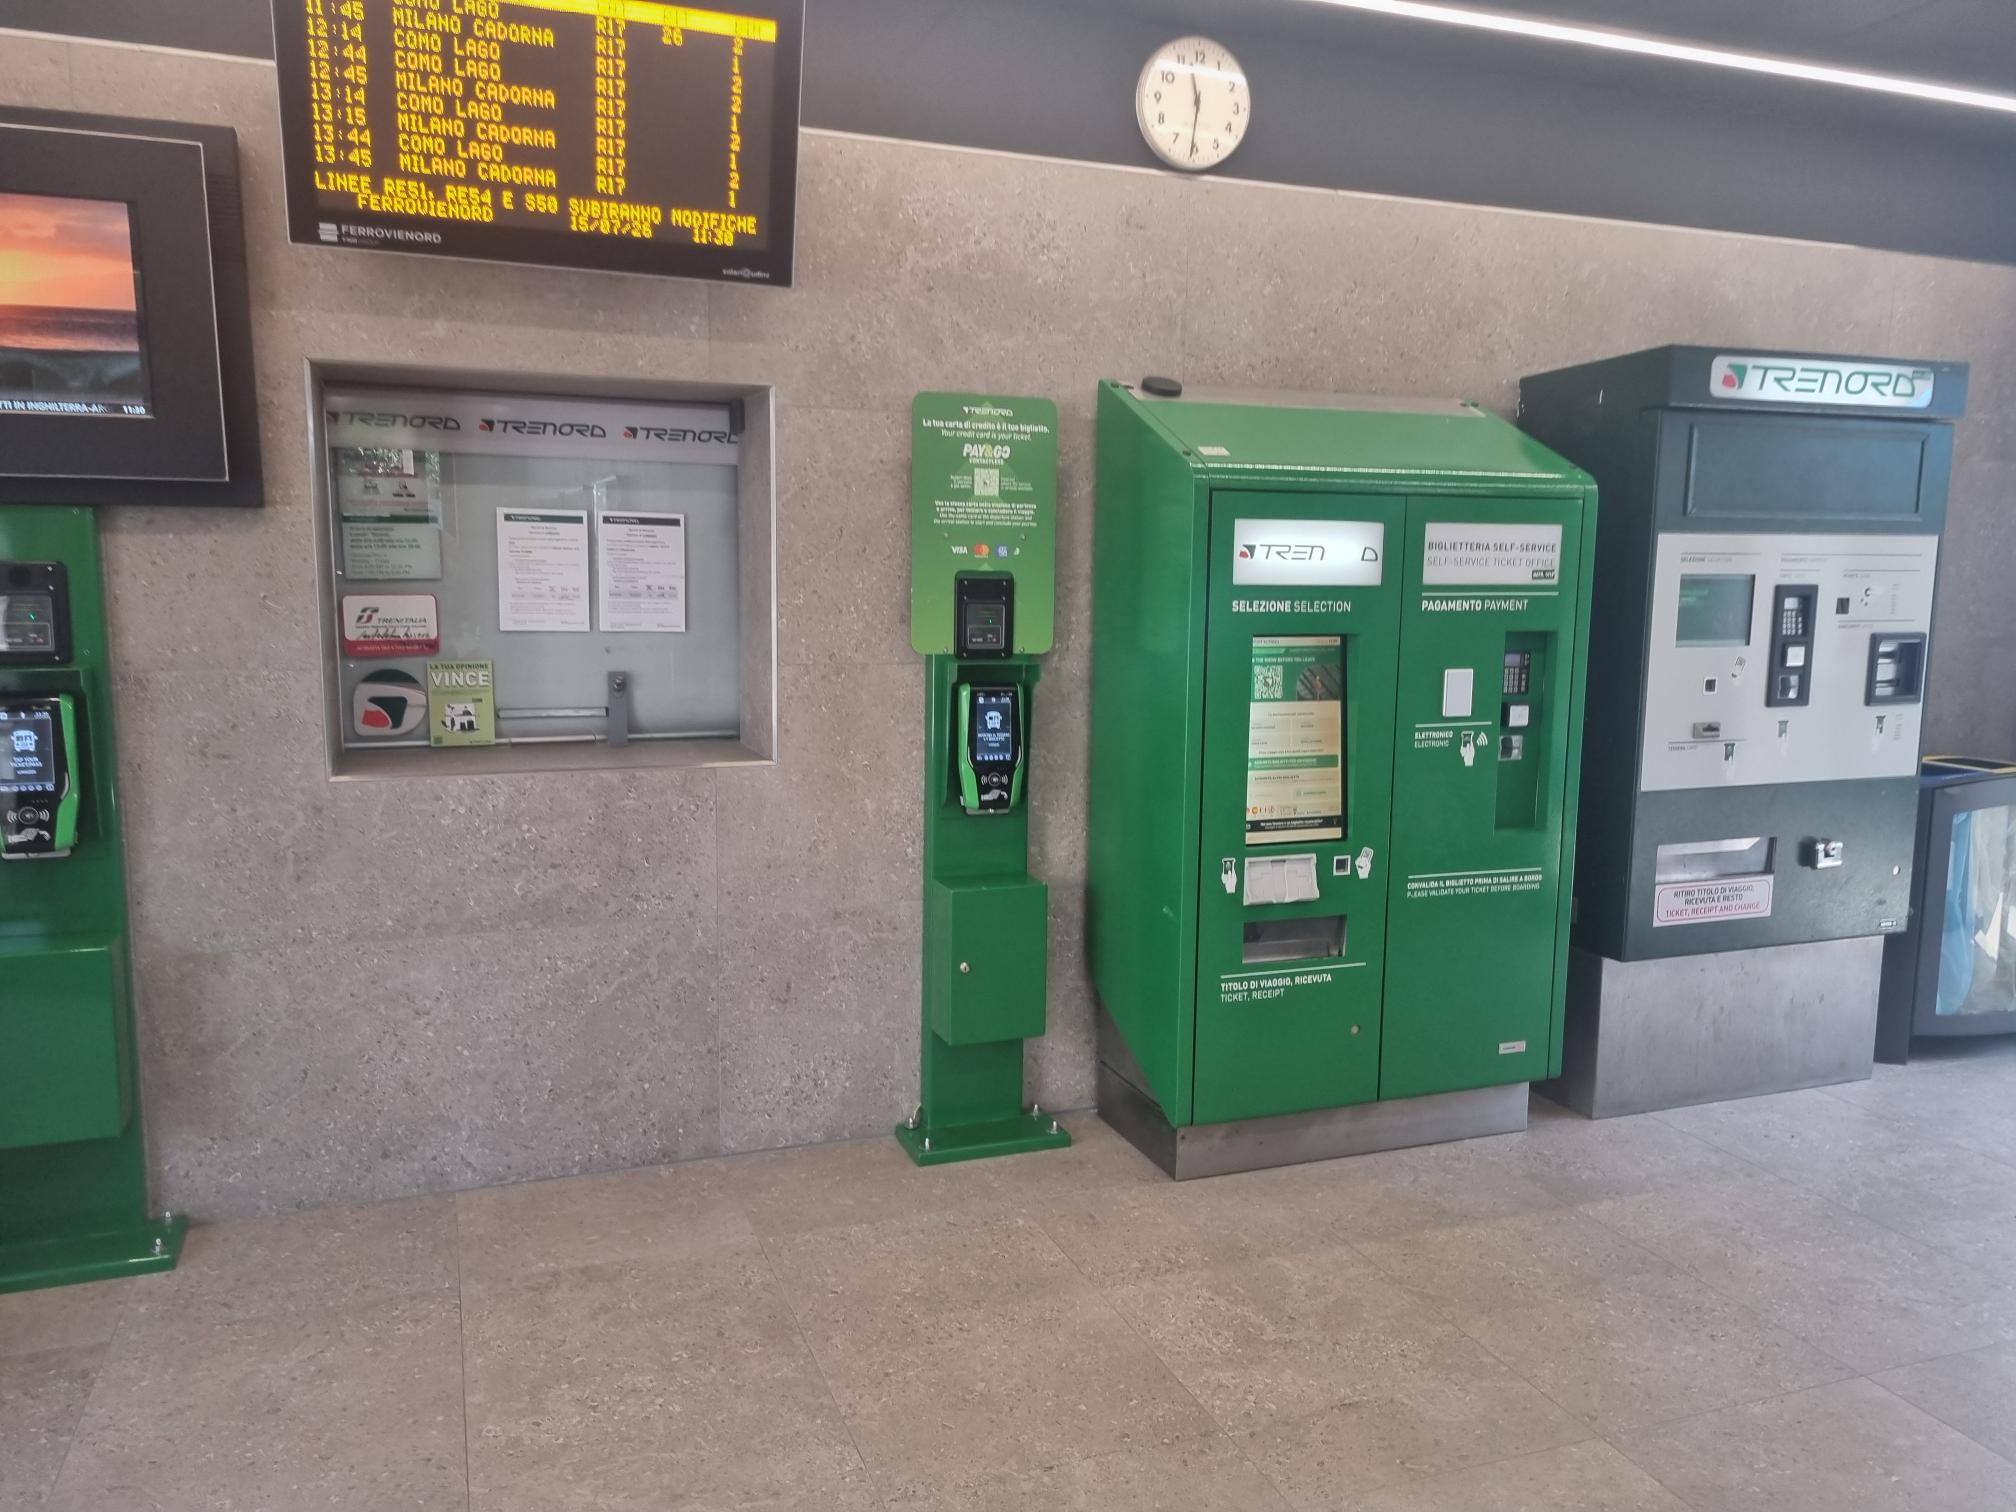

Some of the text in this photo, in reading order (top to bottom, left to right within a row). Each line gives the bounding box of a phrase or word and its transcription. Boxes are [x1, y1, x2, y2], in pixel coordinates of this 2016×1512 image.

[595, 16, 626, 38] R17
[306, 0, 740, 75] 11:45 MILANO CADORNA R17 1
[307, 16, 362, 42] 12:14
[393, 27, 442, 53] COMO
[453, 36, 500, 61] LAGO
[595, 55, 626, 78] R17
[1177, 55, 1186, 65] 11
[1195, 50, 1206, 65] 12
[308, 38, 366, 64] 12:44
[394, 49, 442, 74] COMO
[454, 57, 500, 82] LAGO
[595, 75, 626, 98] R17
[1217, 60, 1221, 71] 1
[1161, 70, 1175, 84] 10
[1229, 81, 1235, 93] 2
[310, 59, 738, 133] 12:45 MILANO CADORNA R17 1
[1154, 90, 1162, 103] 9
[312, 80, 365, 105] 13:14
[396, 91, 444, 115] COMO
[455, 98, 502, 122] LAGO
[595, 115, 626, 138] R17
[1232, 102, 1239, 115] 3
[1157, 111, 1165, 125] 8
[1225, 121, 1232, 135] 4
[312, 102, 737, 171] 13:15 MILANO CADORNA R17 1
[1172, 132, 1180, 144] 7
[313, 123, 370, 147] 13:44
[398, 133, 445, 156] COMO
[456, 139, 503, 162] LAGO
[595, 155, 626, 177] R17
[1212, 138, 1219, 150] 5
[315, 143, 735, 208] 13:45 MILANO CADORNA R17 1
[315, 170, 372, 194] LINEE
[502, 190, 514, 210] E
[568, 198, 662, 225] SUBIRANNO
[341, 224, 442, 244] FERROVIENORD
[1751, 365, 1915, 397] TRENORD
[969, 406, 1014, 416] TRENORD
[342, 412, 460, 431] TRENORD
[922, 418, 931, 427] La
[932, 419, 944, 428] tua
[945, 420, 962, 429] carta
[963, 421, 970, 429] di
[971, 421, 995, 430] credito
[1008, 423, 1019, 432] tuo
[497, 419, 606, 439] TRENORD
[941, 428, 955, 436] Your
[956, 430, 975, 438] credit
[976, 431, 990, 439] card
[998, 432, 1012, 441] your
[962, 442, 1010, 459] PAY&GO
[951, 545, 968, 555] VISA
[1428, 541, 1556, 553] BIGLIETTERIA SELF-SERVICE
[1232, 600, 1351, 613] SELEZIONE SELECTION
[1422, 599, 1528, 612] PAGAMENTO PAYMENT
[431, 671, 489, 687] VINCE
[1414, 730, 1453, 740] ELETTRONICO
[1414, 740, 1449, 748] ELECTRONIC
[1407, 881, 1438, 890] CONVALIDA
[1445, 879, 1473, 888] BIGLIETTO
[1474, 877, 1492, 886] PRIMA
[1407, 889, 1427, 899] PLEASE
[1429, 888, 1454, 897] VALIDATE
[1455, 887, 1469, 895] YOUR
[1471, 886, 1488, 894] TICKET
[1673, 889, 1695, 898] RITIRO
[1697, 887, 1719, 896] TITOLO
[1720, 886, 1727, 895] DI
[1684, 896, 1715, 906] RICEVUTA
[1722, 893, 1743, 902] RESTO
[1666, 902, 1760, 917] TICKET, RECEIPT AND CHANGE
[1220, 973, 1332, 992] TITOLO DI VIAGGIO, RICEVUTA
[1220, 988, 1285, 1003] TICKET, RECEIPT
